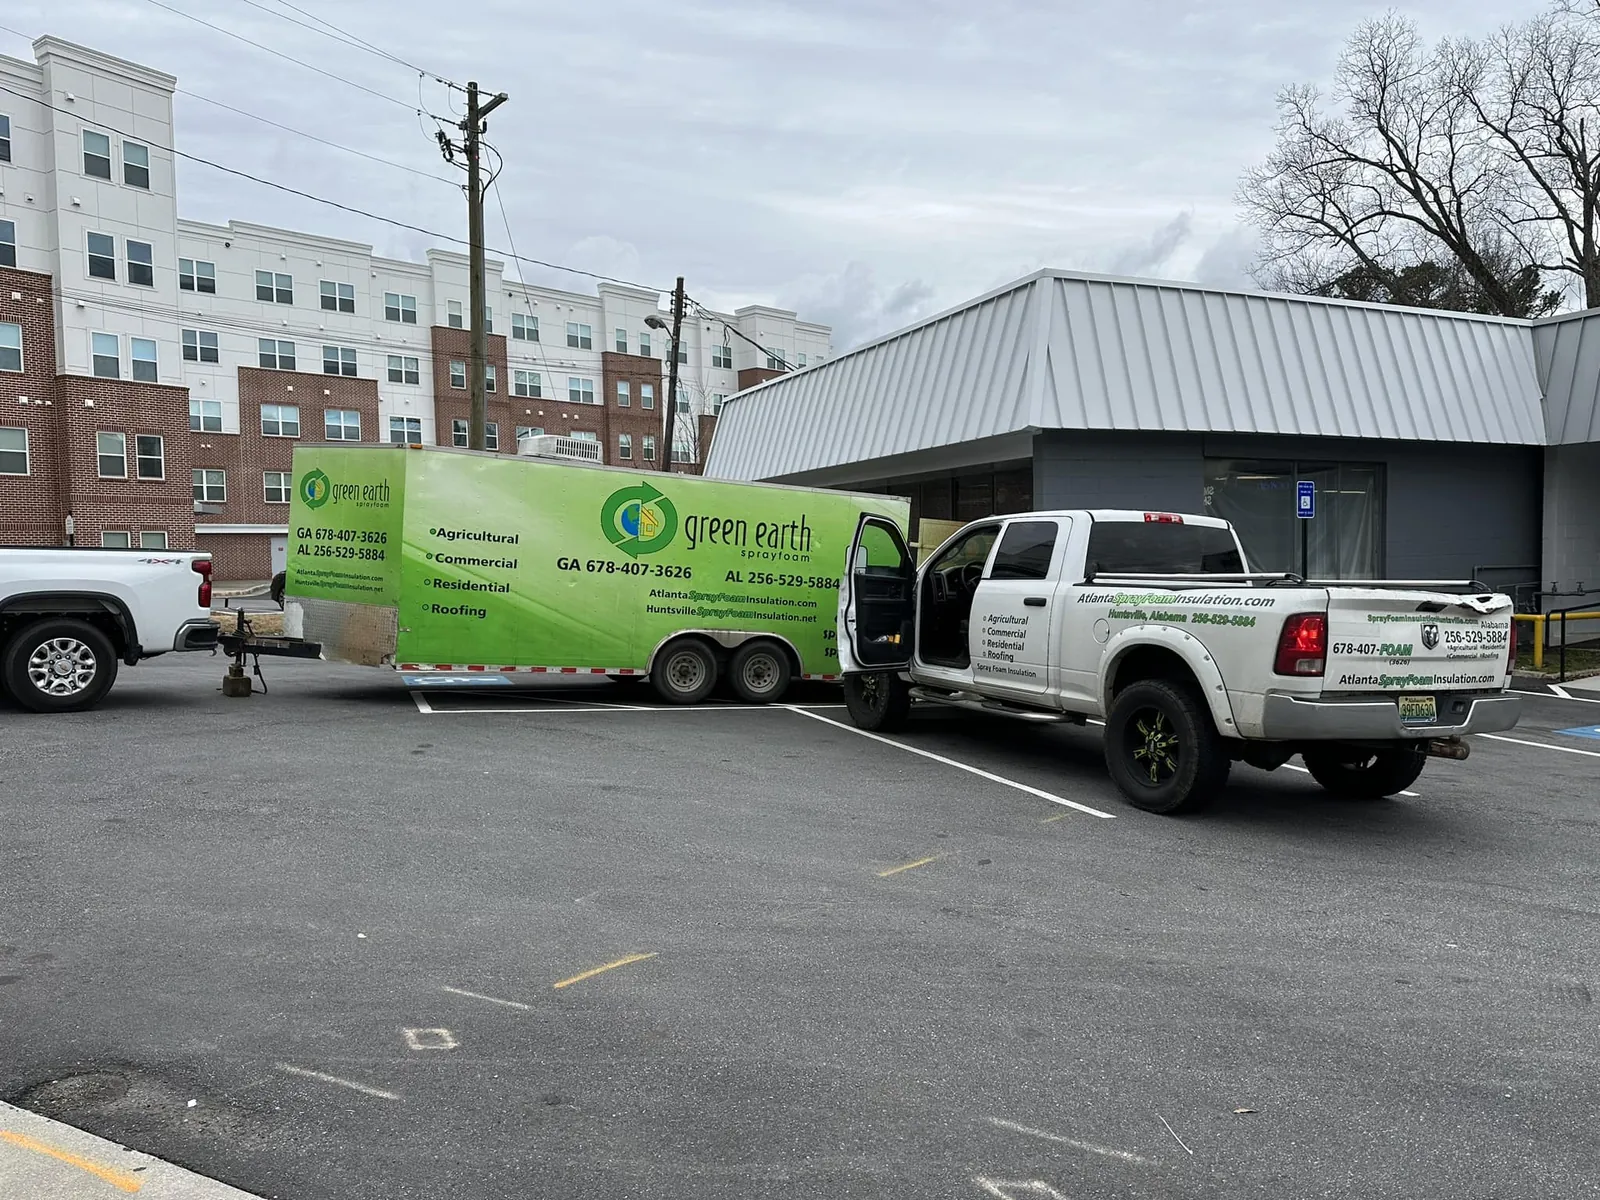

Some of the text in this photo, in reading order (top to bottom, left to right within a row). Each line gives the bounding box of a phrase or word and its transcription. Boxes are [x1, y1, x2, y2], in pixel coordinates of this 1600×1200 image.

[332, 478, 390, 504] green earth
[356, 501, 390, 509] sprayfoam
[297, 527, 387, 545] GA 678-407-3626
[436, 527, 519, 545] Agricultural
[685, 514, 812, 551] green earth
[297, 544, 385, 561] AL 256-529-5884
[741, 549, 811, 563] sprayfoam
[435, 553, 518, 569] Commercial
[557, 557, 692, 579] GA 678-407-3626
[433, 578, 510, 594] Residential
[725, 570, 840, 590] AL 256-529-5884
[431, 603, 487, 619] Roofing
[1149, 610, 1187, 623] Alabama
[1191, 612, 1256, 628] 256-529-5884
[987, 614, 1029, 626] Agricultural
[1480, 620, 1509, 629] Alabama
[987, 627, 1027, 639] Commercial
[1444, 630, 1508, 643] 256-529-5884
[987, 639, 1025, 651] Residential
[1332, 643, 1414, 656] 678-407-FOAM
[987, 650, 1014, 663] Roofing
[1388, 658, 1411, 666] (3626)
[976, 663, 1037, 679] Spray Foam Insulation
